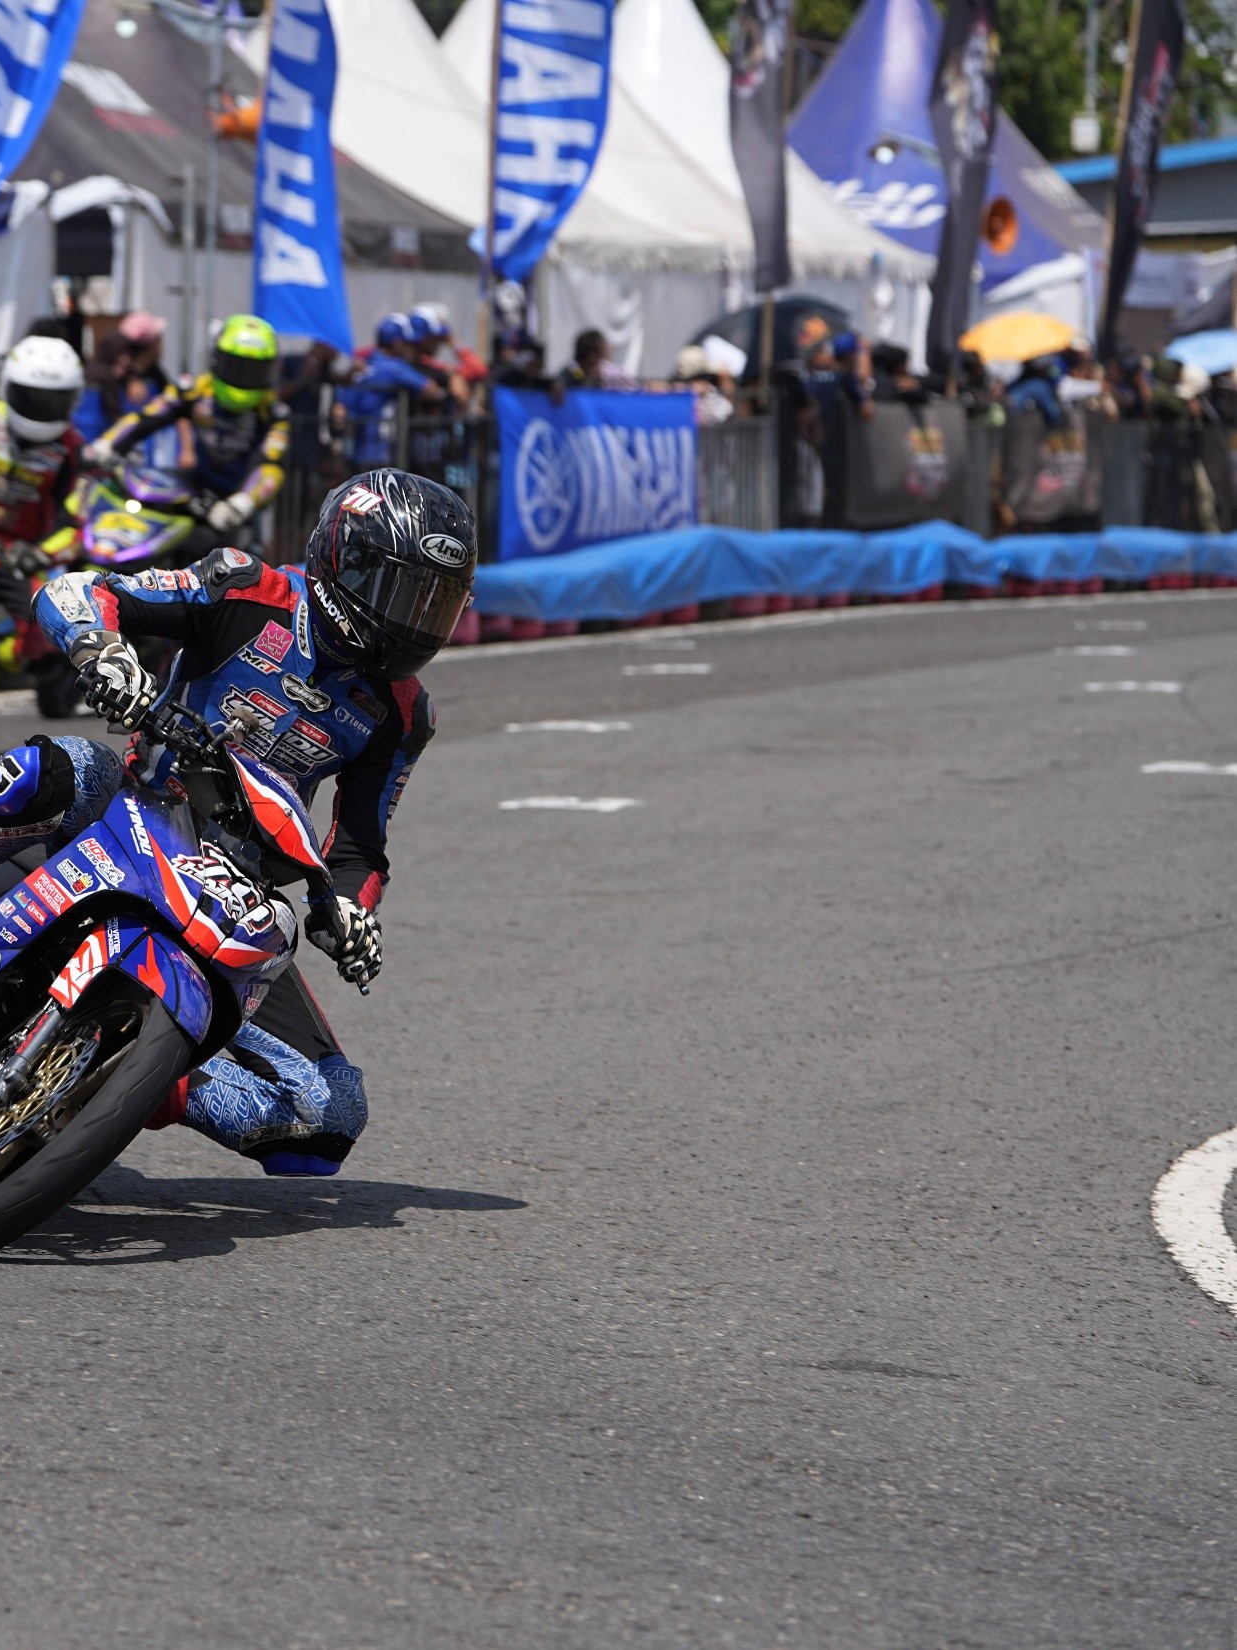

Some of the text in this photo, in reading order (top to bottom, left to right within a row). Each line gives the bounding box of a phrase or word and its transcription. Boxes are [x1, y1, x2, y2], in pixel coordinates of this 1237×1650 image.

[341, 485, 384, 516] 70
[425, 538, 466, 562] Arai
[313, 582, 345, 623] ENJOY
[124, 797, 153, 857] WINDU
[78, 842, 99, 866] RACING
[84, 838, 111, 862] HDS
[37, 874, 66, 905] PRIVATER
